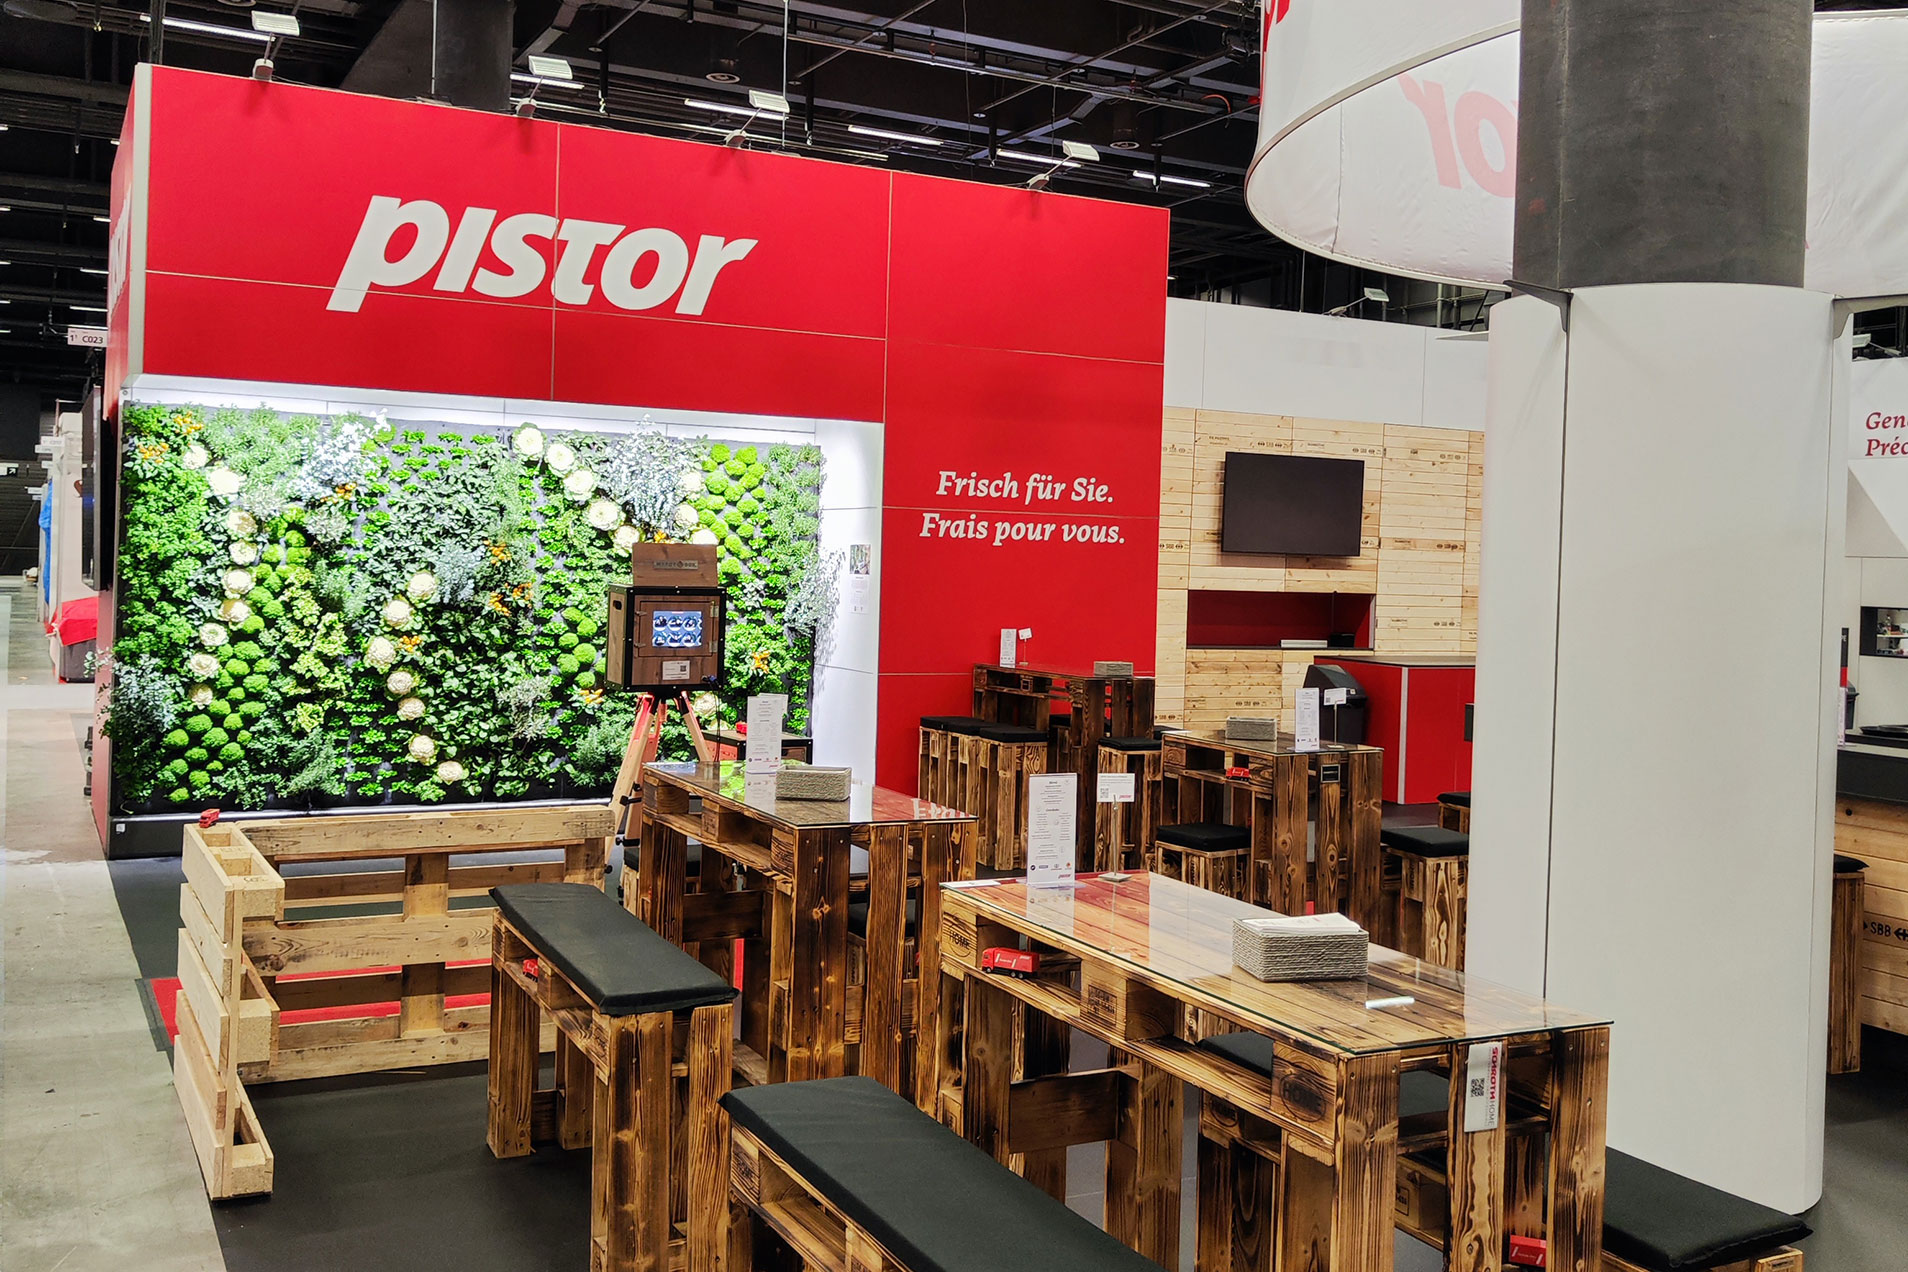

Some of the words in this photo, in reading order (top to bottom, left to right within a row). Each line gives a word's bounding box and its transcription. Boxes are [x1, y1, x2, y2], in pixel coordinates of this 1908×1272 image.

[325, 194, 760, 316] pistor
[81, 335, 104, 344] C023
[1866, 411, 1908, 430] Gen
[936, 470, 1019, 499] Frisch
[1024, 473, 1067, 506] für
[1070, 477, 1114, 503] Sie.
[919, 512, 989, 540] Frais
[992, 520, 1056, 547] pour
[1061, 523, 1126, 544] vous.
[1870, 921, 1891, 937] SBB
